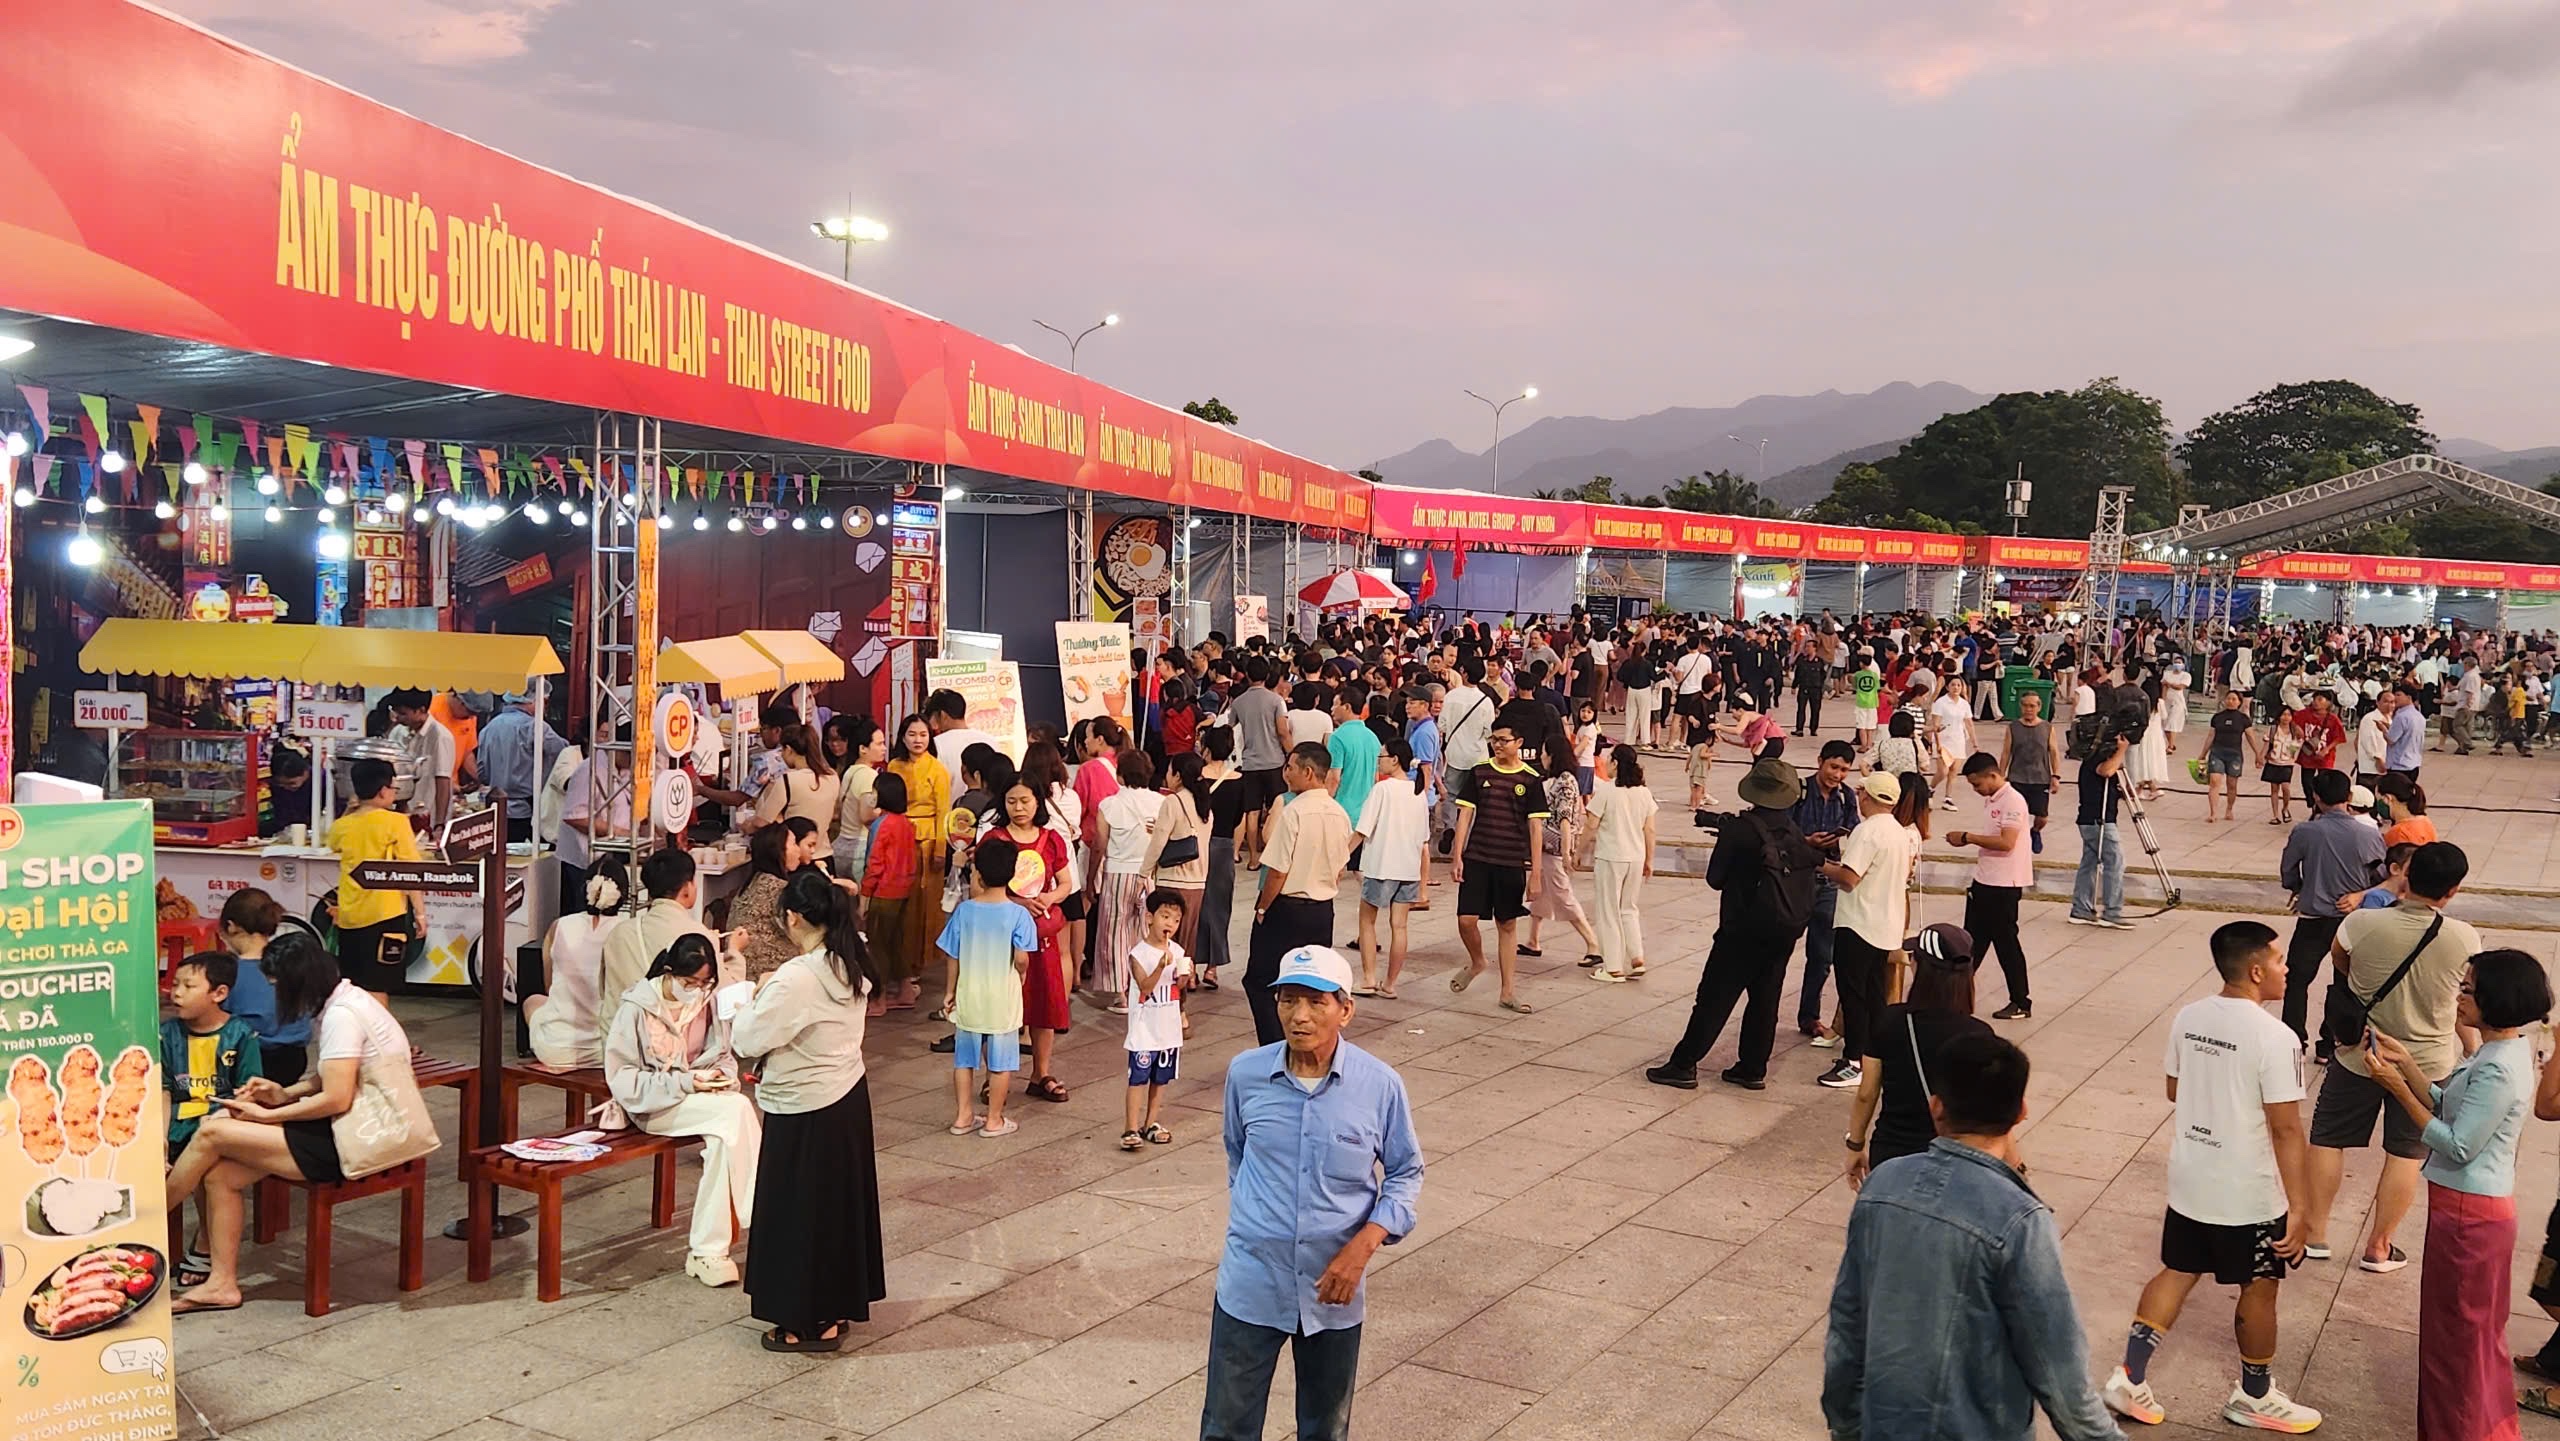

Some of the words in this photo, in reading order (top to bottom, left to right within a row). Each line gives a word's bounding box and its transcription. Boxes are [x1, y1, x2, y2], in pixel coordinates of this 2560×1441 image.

[276, 111, 340, 298] ẨM
[350, 184, 438, 340] THỰC
[447, 202, 546, 343] ĐƯỜNG
[554, 228, 604, 355] PHỐ
[610, 257, 660, 367] THÁI
[667, 284, 706, 378] LAN
[712, 337, 720, 354] -
[725, 302, 765, 391] THAI
[771, 317, 830, 405] STREET
[833, 337, 871, 414] FOOD
[968, 360, 987, 433] ẨM
[988, 386, 1016, 450] THỰC
[1018, 396, 1044, 448] SIAM
[1045, 400, 1066, 452] THÁI
[1067, 411, 1085, 457] LAN
[1100, 406, 1113, 463] ẨM
[1114, 426, 1135, 476] THỰC
[1136, 427, 1151, 473] HÀN
[1152, 429, 1171, 479] QUỐC
[1412, 501, 1425, 526] ẨM
[1427, 507, 1446, 532] THỰC
[1447, 510, 1467, 528] ANYA
[1468, 511, 1490, 529] HOTEL
[1492, 512, 1516, 531] GROUP
[1521, 515, 1535, 533] QUY
[1536, 515, 1556, 533] NHƠN
[1742, 568, 1775, 582] Xanh
[956, 675, 996, 686] COMBO
[999, 676, 1012, 686] CP
[80, 706, 128, 721] 20.000
[299, 715, 345, 730] 15.000
[669, 715, 688, 737] CP
[22, 853, 145, 889] SHOP
[364, 870, 388, 882] Wat
[388, 871, 422, 883] Arun,
[424, 871, 475, 885] Bangkok
[59, 890, 129, 932] Hội
[7, 943, 55, 963] CHƠI
[60, 938, 99, 959] THẢ
[102, 940, 129, 955] GA
[0, 971, 111, 1000] OUCHER
[18, 1004, 58, 1032] ĐÃ
[3, 1033, 35, 1051] TRÊN
[16, 1408, 49, 1426] MUA
[92, 1388, 140, 1408] NGAY
[143, 1384, 171, 1400] TẠI
